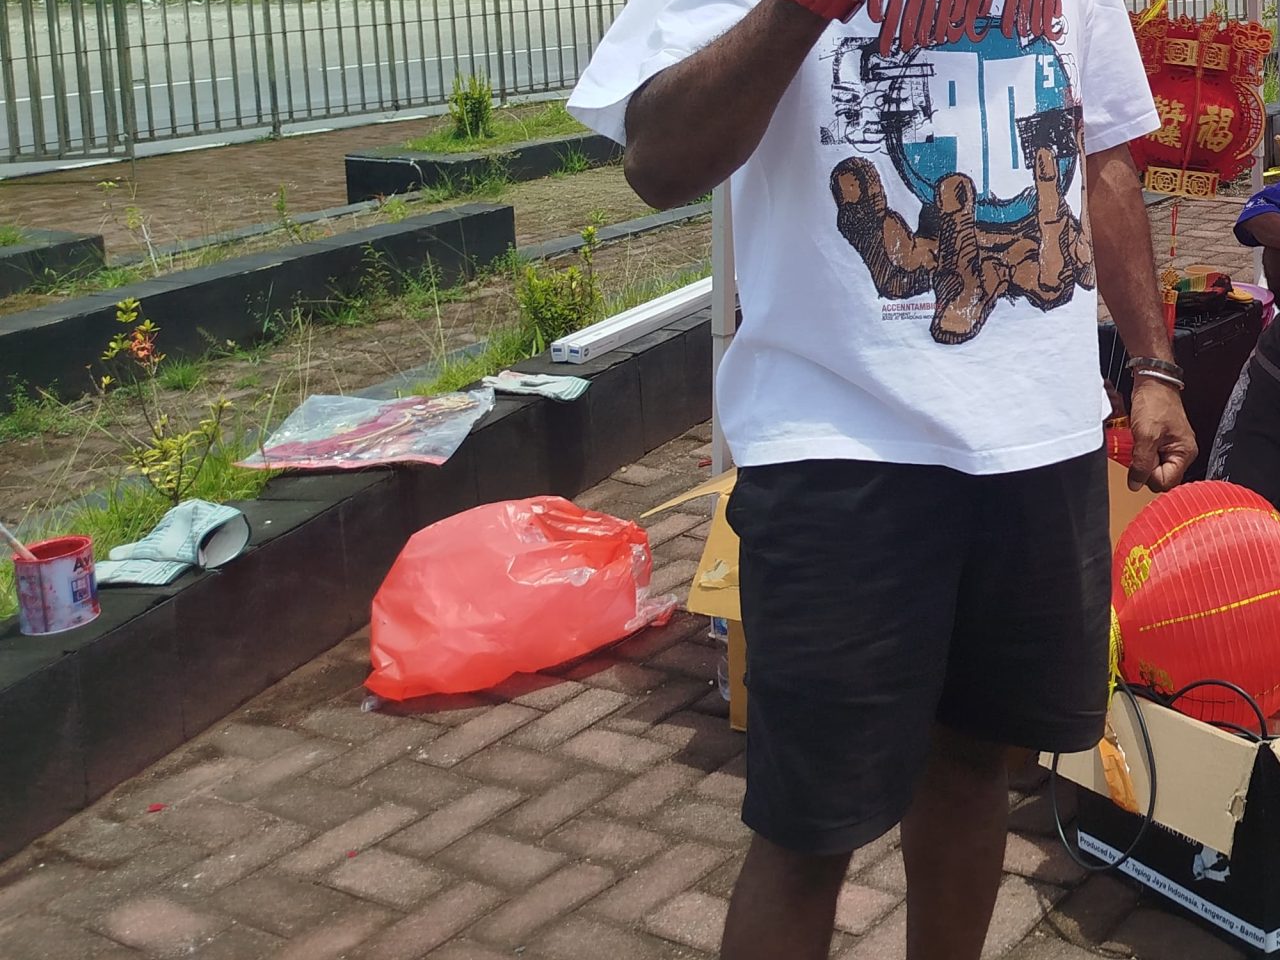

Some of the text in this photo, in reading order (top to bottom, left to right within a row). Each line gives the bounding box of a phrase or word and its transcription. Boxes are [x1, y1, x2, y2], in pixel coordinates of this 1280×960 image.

[1198, 104, 1235, 153] 福
[1079, 835, 1108, 857] Produced
[1108, 849, 1117, 863] by
[1151, 875, 1167, 891] Jaya
[1200, 903, 1235, 930] Tangerang
[1239, 924, 1265, 944] Banten
